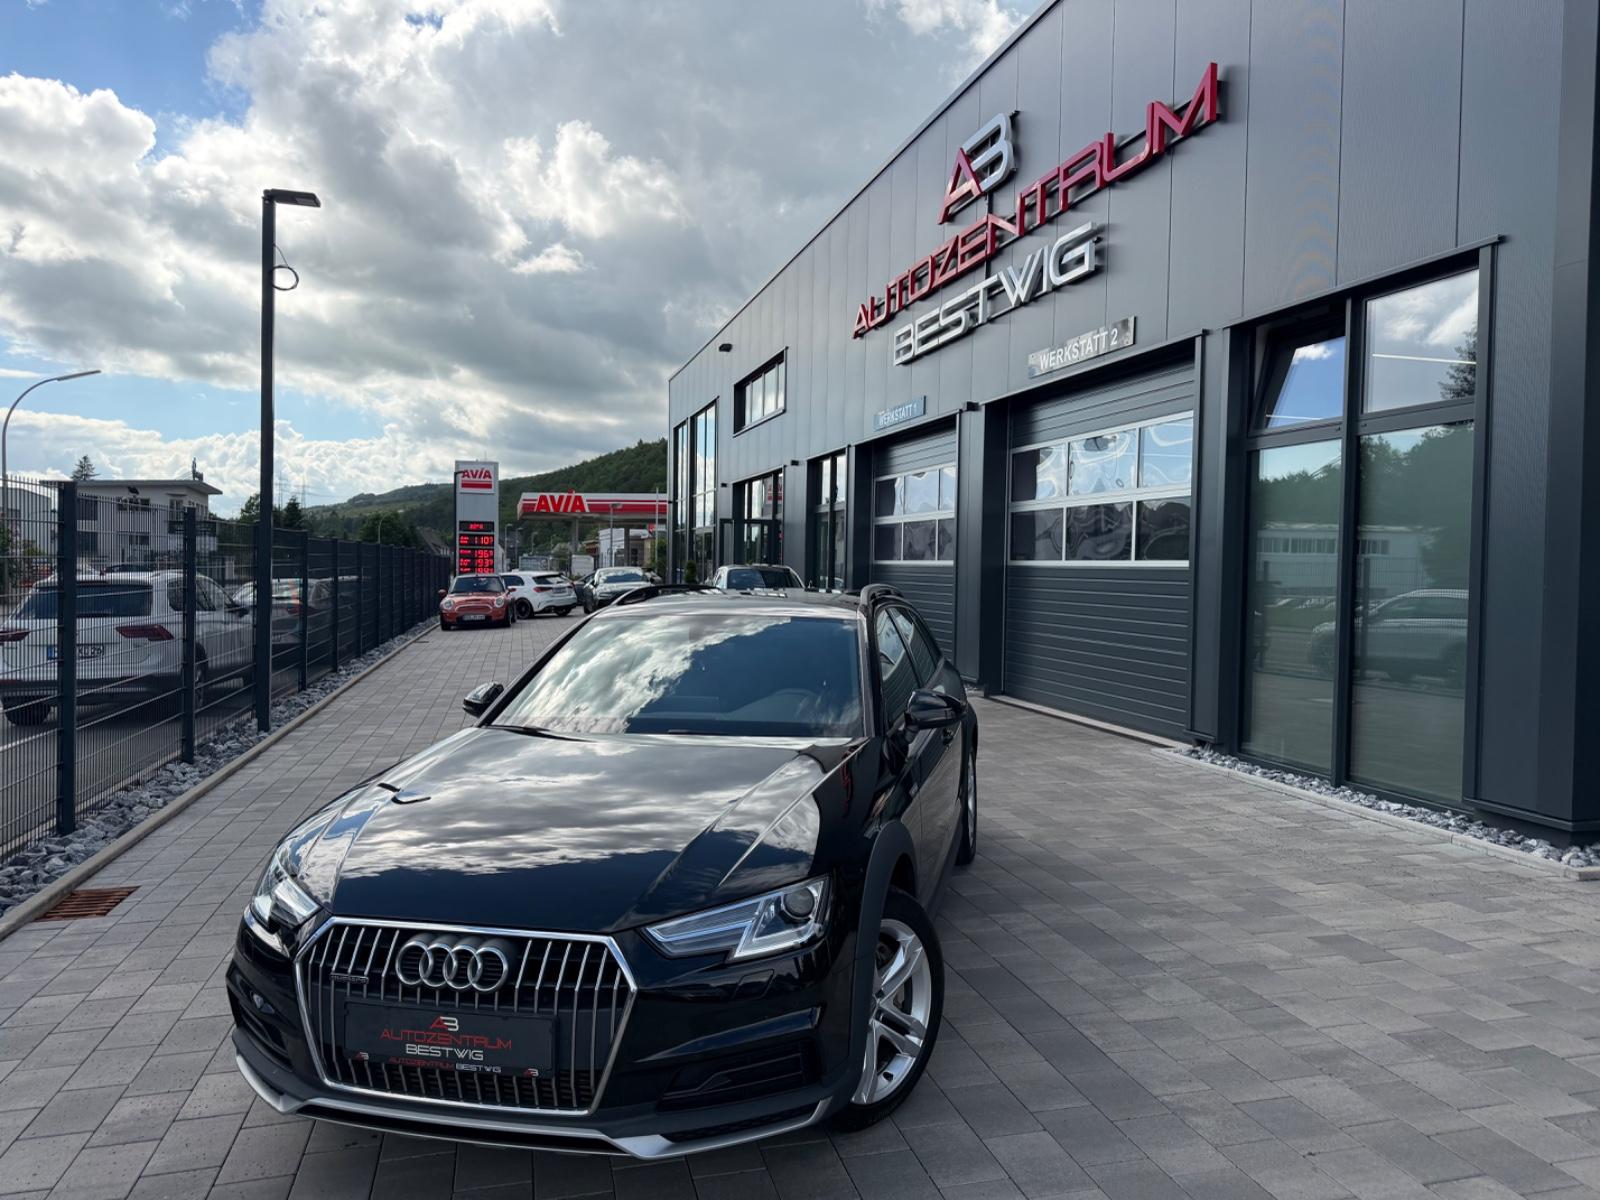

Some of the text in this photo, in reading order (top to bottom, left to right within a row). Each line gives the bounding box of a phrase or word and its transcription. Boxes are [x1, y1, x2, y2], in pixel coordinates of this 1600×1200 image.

[852, 62, 1219, 339] AUTOZENTRUM
[892, 222, 1099, 366] BESTWIG
[1038, 327, 1119, 372] WERKSTATT 2
[461, 467, 493, 480] AVIA
[534, 489, 587, 513] AVIA
[380, 1028, 513, 1050] AUTOZENTRUM
[405, 1043, 485, 1061] BESTWIG
[455, 1062, 502, 1074] BESTWIG
